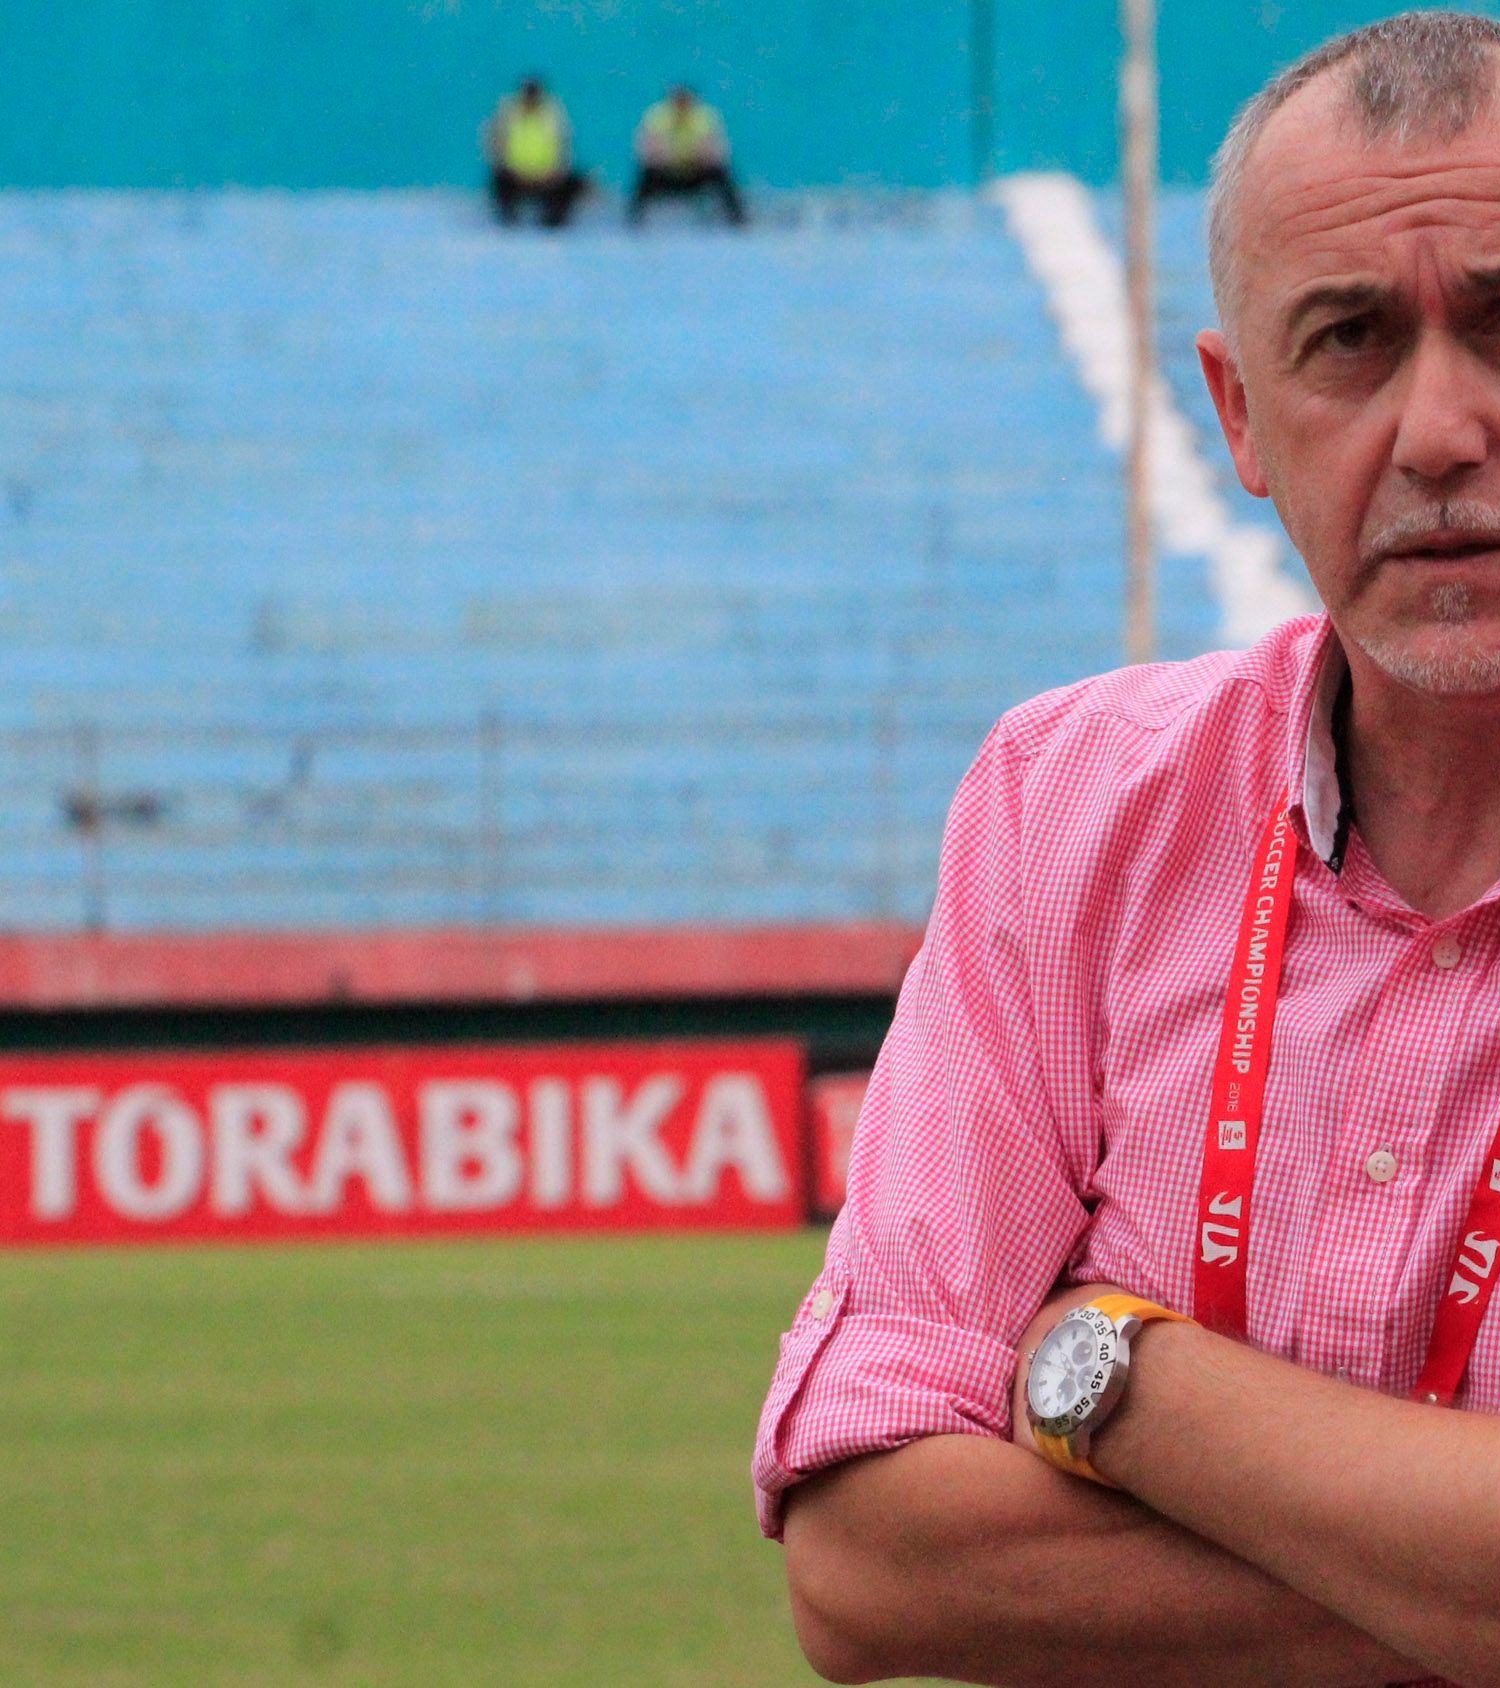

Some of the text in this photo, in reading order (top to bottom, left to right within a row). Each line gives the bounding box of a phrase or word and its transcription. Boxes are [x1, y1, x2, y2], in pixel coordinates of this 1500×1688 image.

[1259, 808, 1289, 892] SOCCER
[1231, 895, 1275, 1074] CHAMPIONSHIP
[1226, 1082, 1241, 1112] 2016
[2, 1072, 788, 1222] TORABIKA
[1080, 1310, 1095, 1321] 30
[1094, 1320, 1108, 1336] 35
[1099, 1342, 1110, 1361] 40
[1090, 1370, 1104, 1390] 45
[1074, 1396, 1091, 1416] 50
